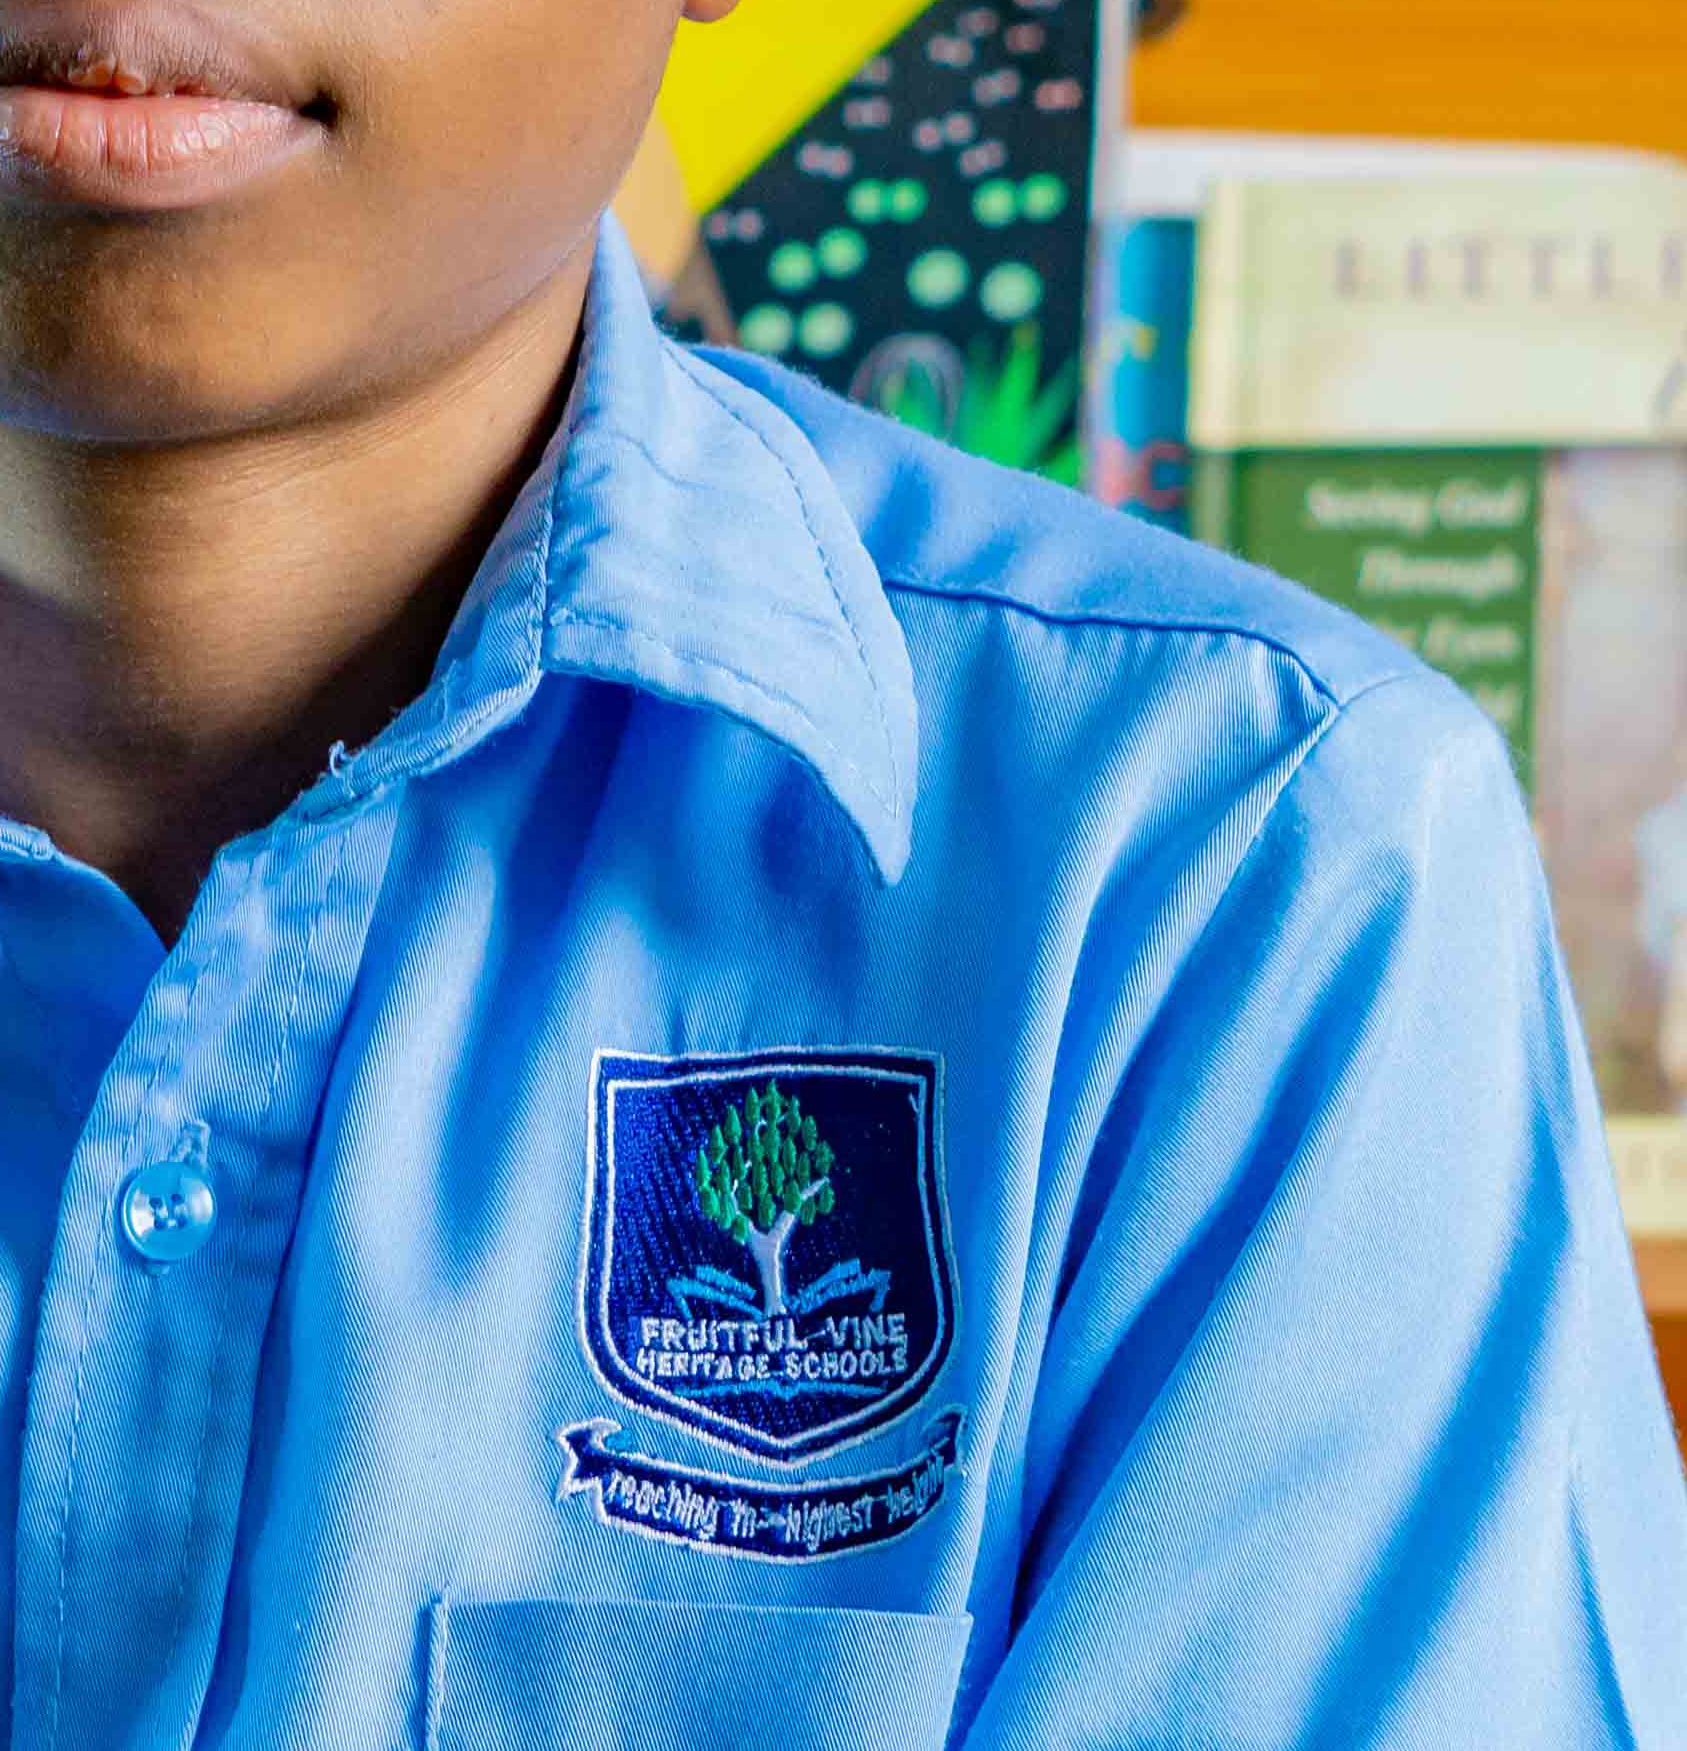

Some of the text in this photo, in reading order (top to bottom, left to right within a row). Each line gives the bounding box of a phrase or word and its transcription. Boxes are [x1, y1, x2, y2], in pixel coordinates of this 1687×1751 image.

[1332, 230, 1687, 300] LITTLE
[640, 1312, 909, 1352] FRUITFUL VINE
[637, 1348, 908, 1380] HERITAGE SCHOOLS
[607, 1468, 721, 1540] reaching
[784, 1496, 874, 1552] highest
